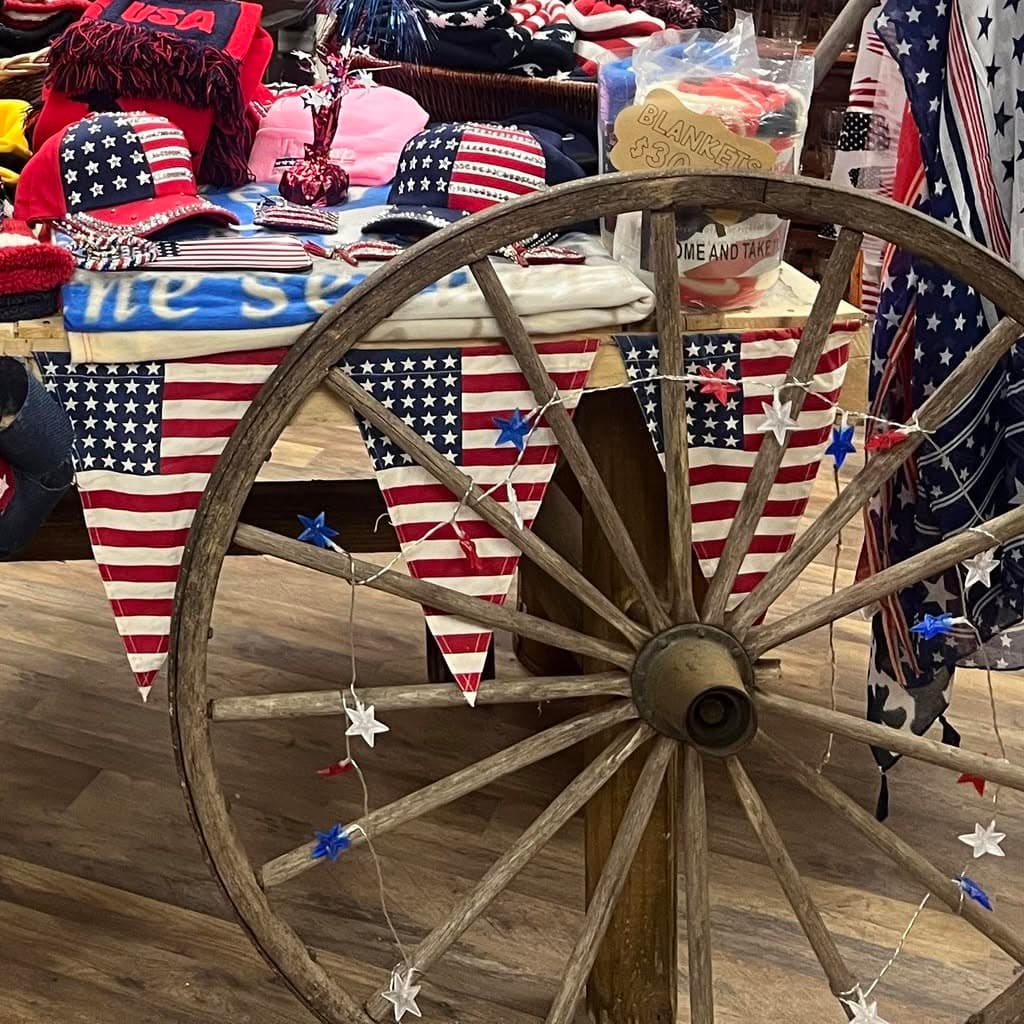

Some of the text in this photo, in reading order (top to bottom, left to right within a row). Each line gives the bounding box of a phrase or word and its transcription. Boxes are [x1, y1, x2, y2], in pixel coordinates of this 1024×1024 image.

[120, 0, 216, 34] USA
[637, 103, 763, 170] BLANKETS
[677, 242, 705, 261] OME
[709, 241, 740, 262] AND
[742, 240, 771, 260] TAKE
